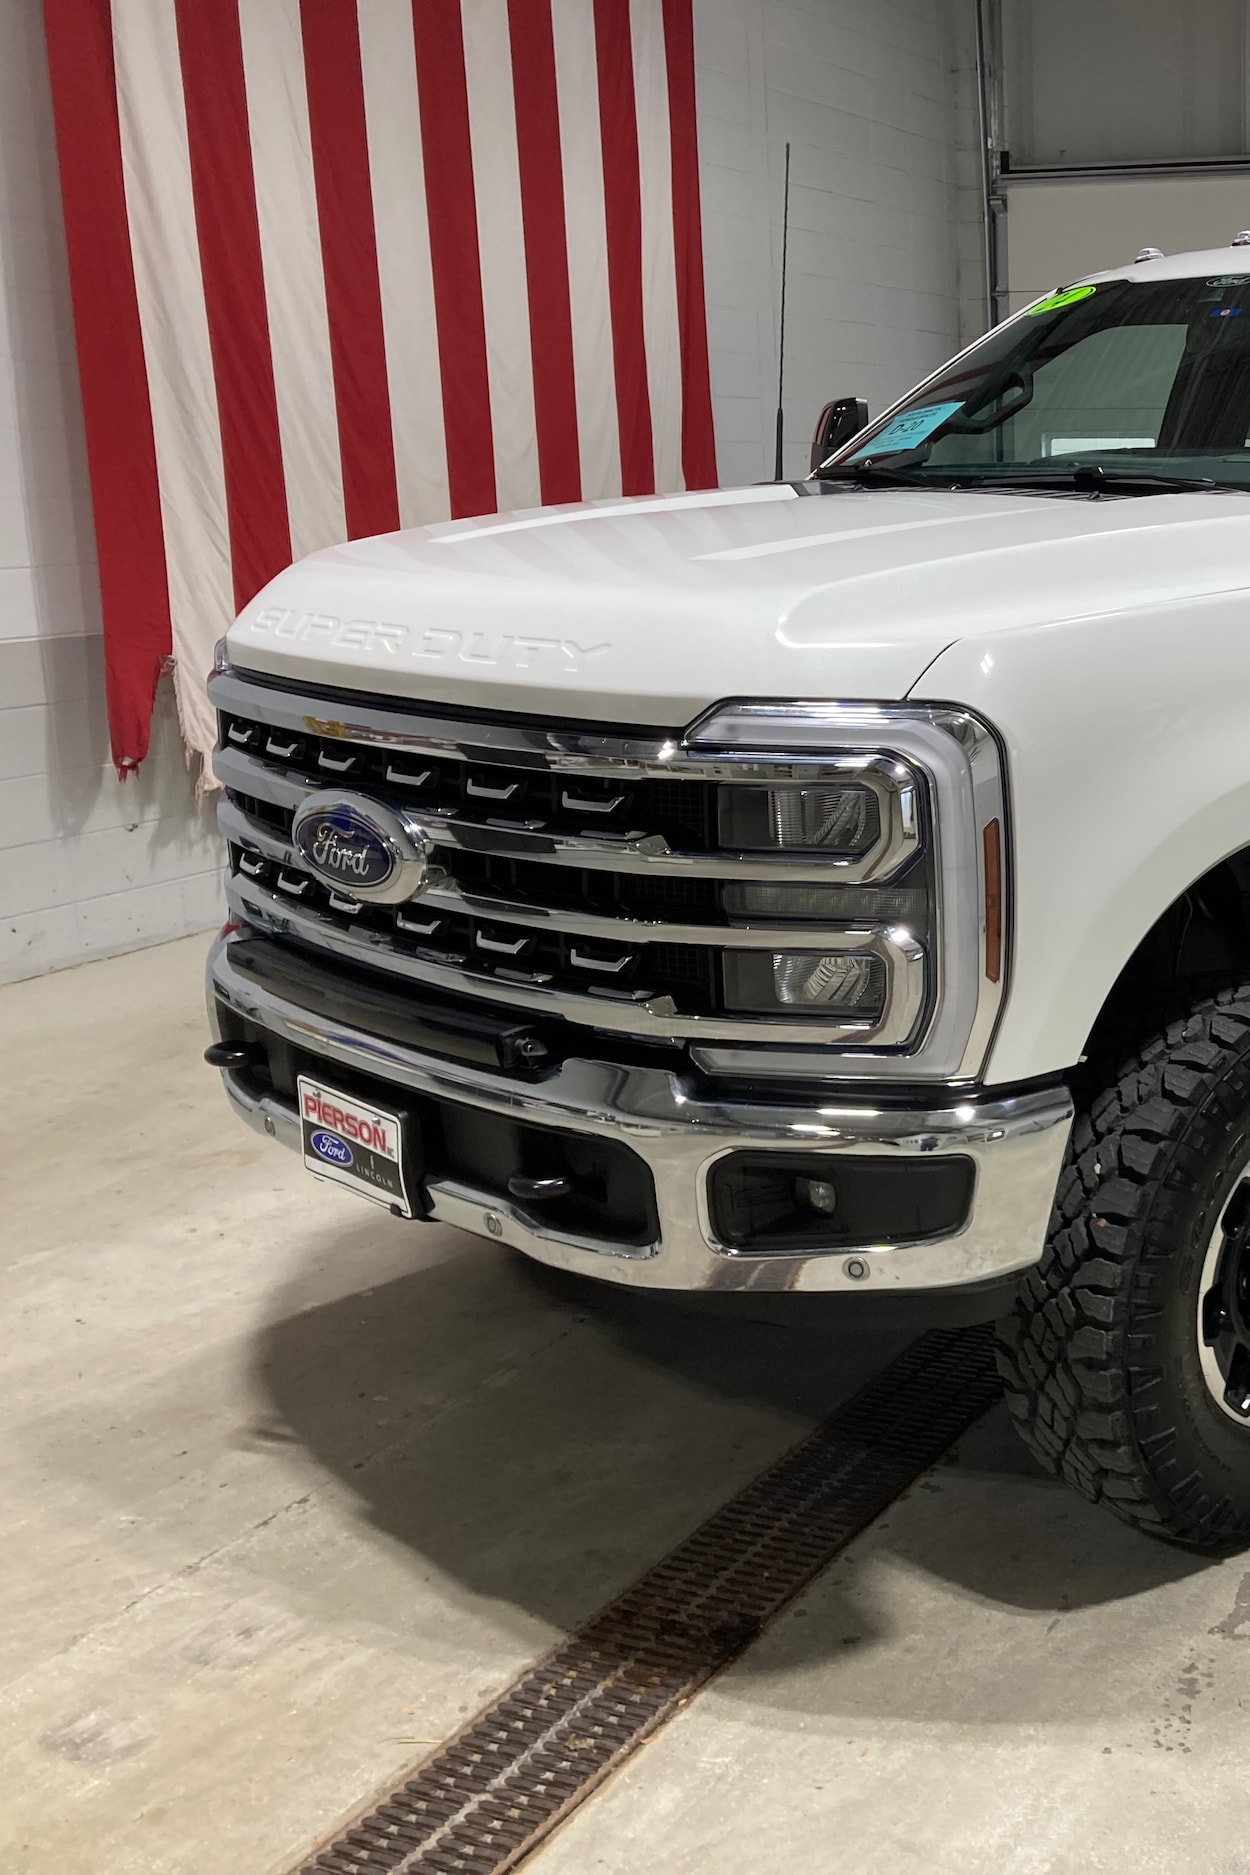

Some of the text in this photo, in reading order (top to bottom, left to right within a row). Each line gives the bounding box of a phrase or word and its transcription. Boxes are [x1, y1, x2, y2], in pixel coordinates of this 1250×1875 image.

[250, 607, 612, 673] SUPER DUTY
[312, 822, 370, 876] Ford
[304, 1094, 386, 1153] PIERSON
[319, 1134, 346, 1161] Ford
[356, 1164, 393, 1188] LINCOLN
